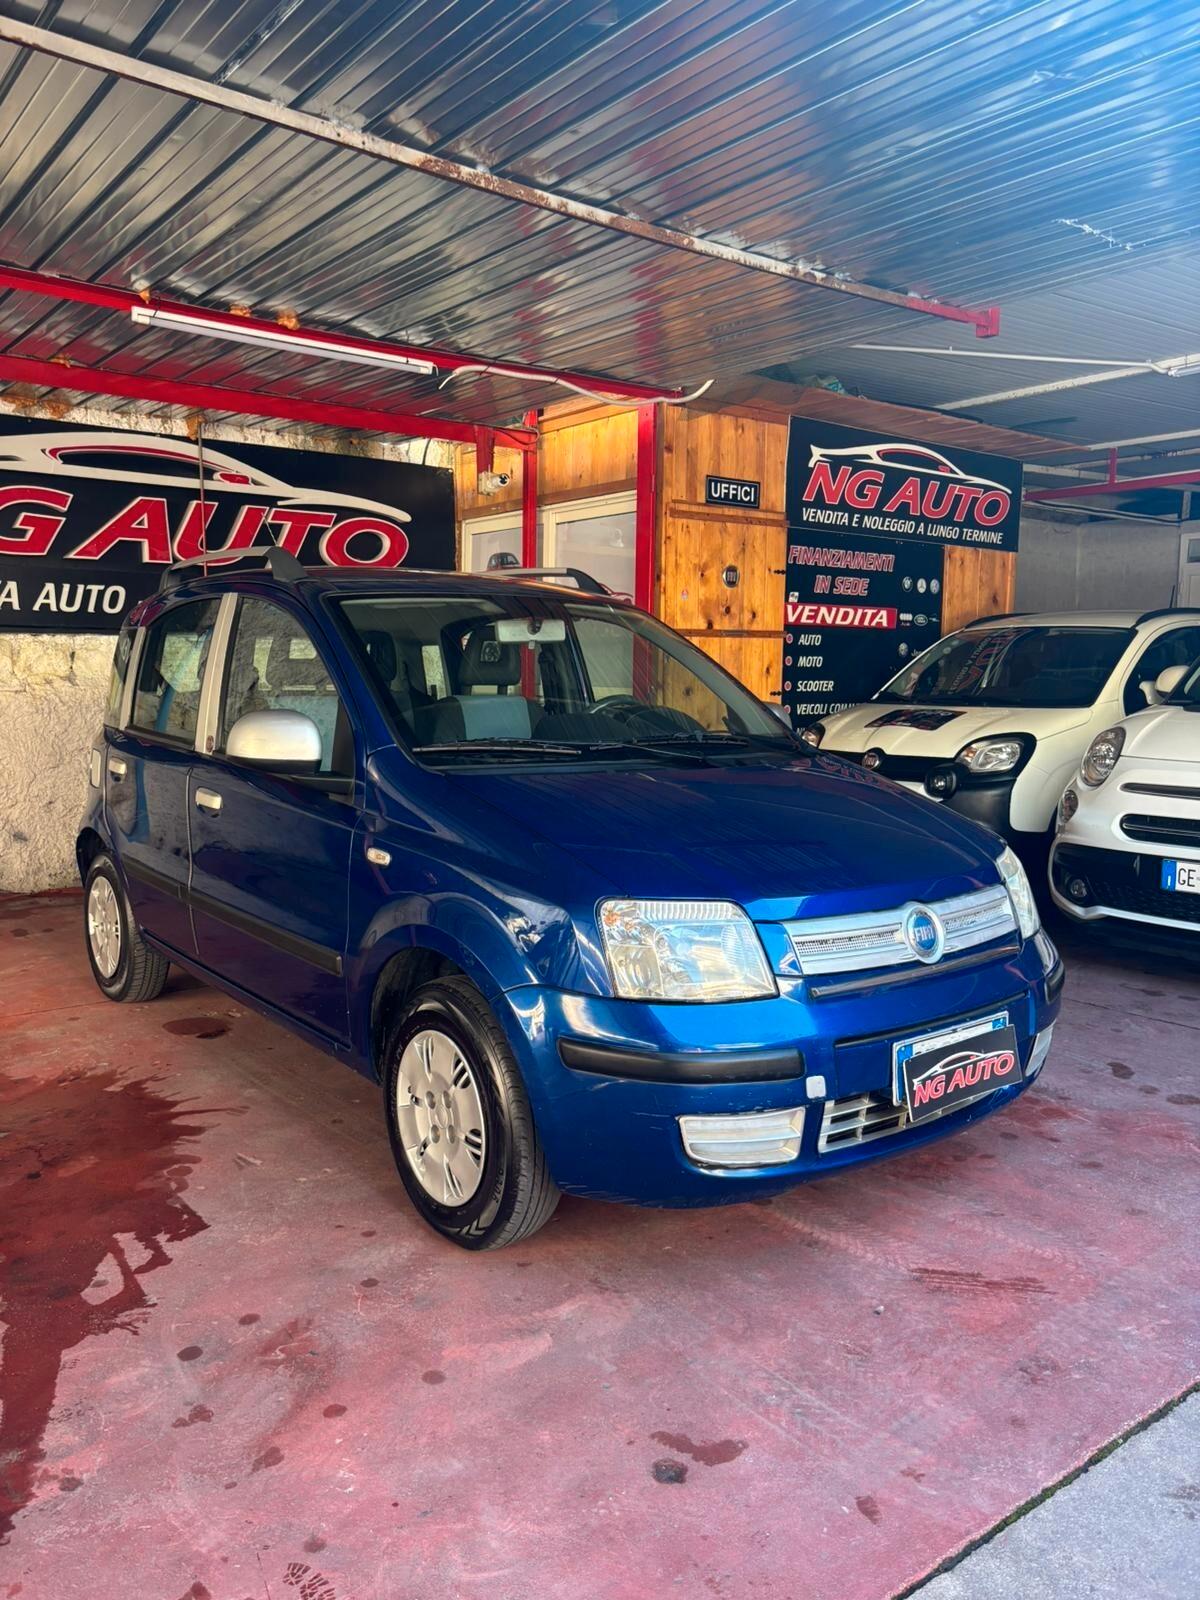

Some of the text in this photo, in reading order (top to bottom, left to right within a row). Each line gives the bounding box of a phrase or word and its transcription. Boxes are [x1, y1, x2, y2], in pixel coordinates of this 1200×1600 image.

[711, 482, 755, 502] UFFICI
[802, 462, 1011, 526] NG AUTO
[65, 497, 410, 567] AUTO
[802, 507, 1004, 545] VENDITA E NOLEGGIO A LUNGO TERMINE
[788, 545, 895, 572] FINANZIAMENTI
[814, 575, 869, 596] IN SEDE
[32, 582, 126, 615] AUTO
[787, 605, 888, 627] VENDITA
[798, 634, 821, 646] AUTO
[797, 656, 823, 667] MOTO
[796, 680, 834, 692] SCOOTER
[796, 703, 828, 715] VEICOLI
[1178, 867, 1196, 887] GE
[914, 1053, 1015, 1107] NG AUTO
